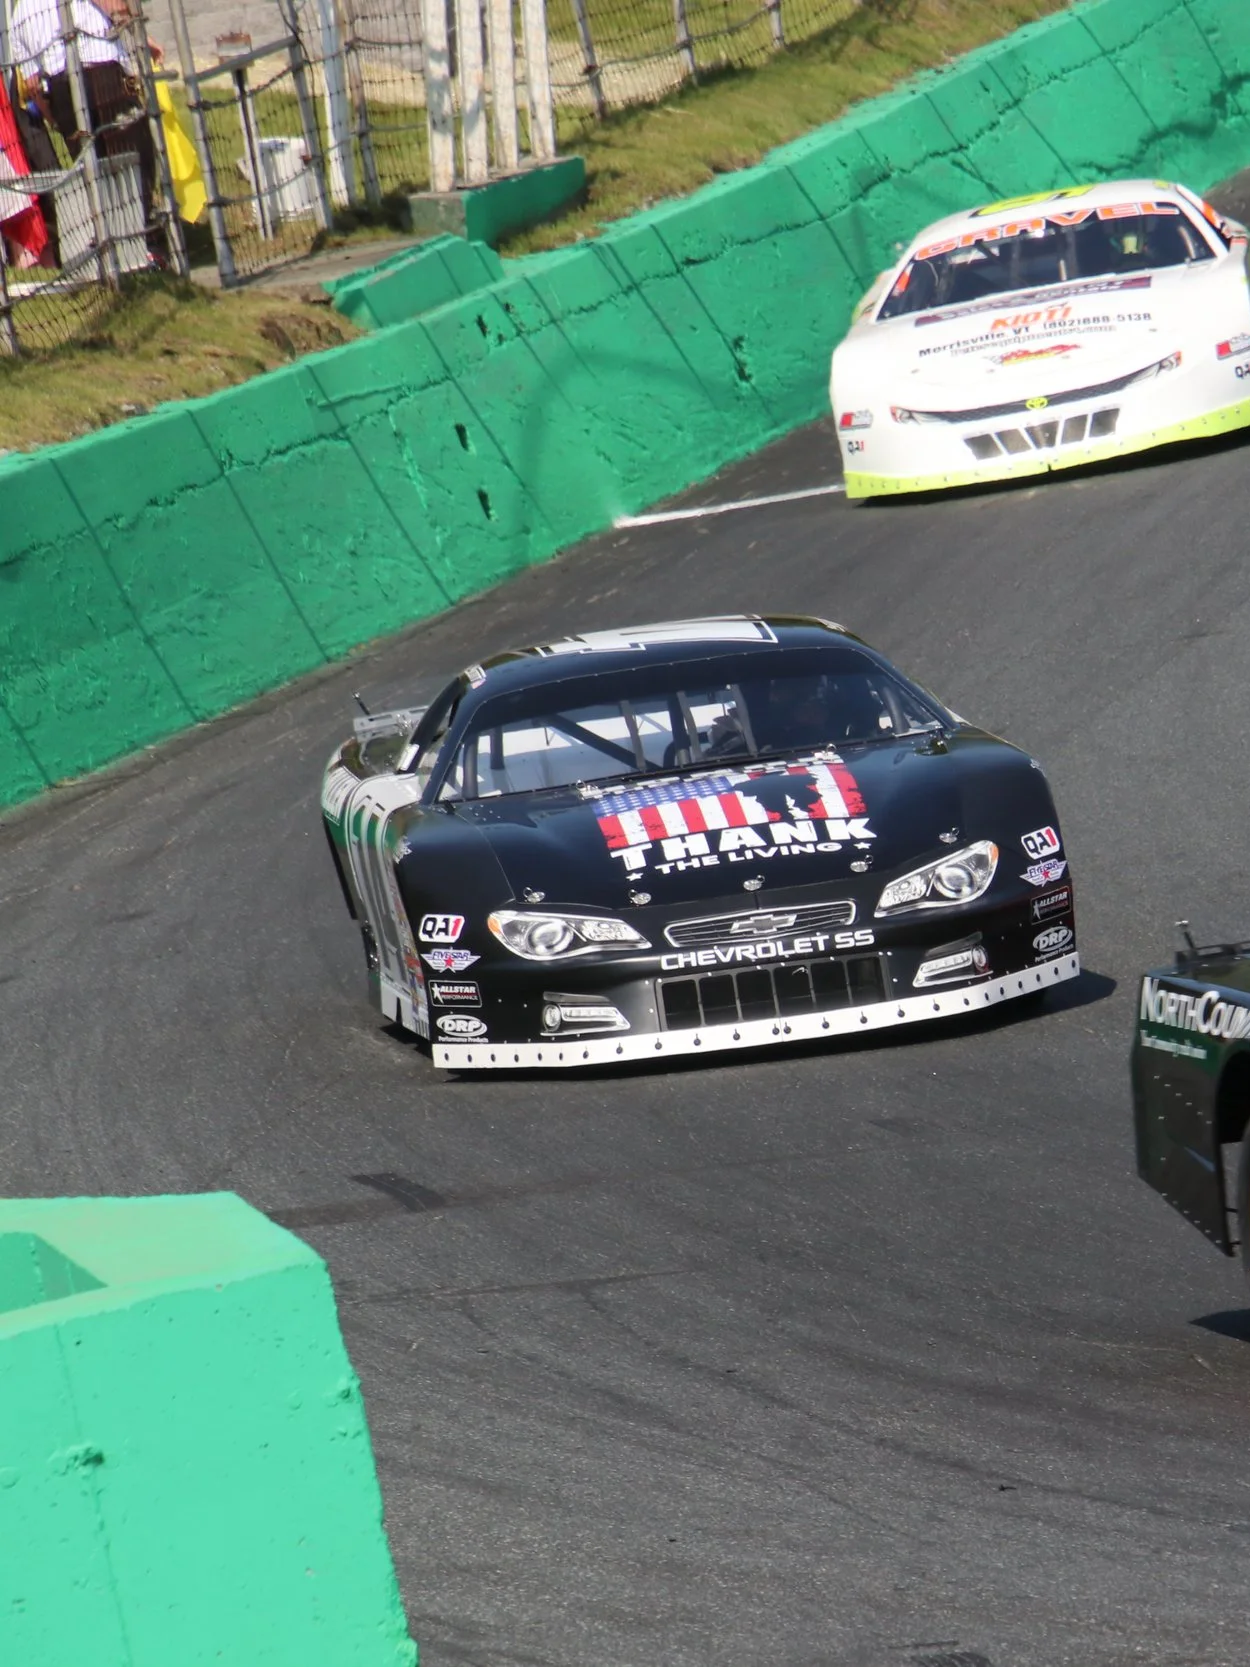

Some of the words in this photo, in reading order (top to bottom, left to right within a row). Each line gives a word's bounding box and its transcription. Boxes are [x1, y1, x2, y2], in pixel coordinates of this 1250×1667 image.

[914, 201, 1180, 261] GRAVEL
[610, 817, 877, 871] THANK
[1023, 828, 1057, 855] QA1
[655, 854, 720, 875] THE
[728, 842, 842, 863] LIVING
[422, 917, 462, 939] QA1
[1039, 929, 1069, 950] DRP
[660, 935, 829, 970] CHEVROLET
[835, 929, 875, 949] SS
[439, 985, 476, 994] ALLSTAR
[443, 1020, 480, 1033] DRP
